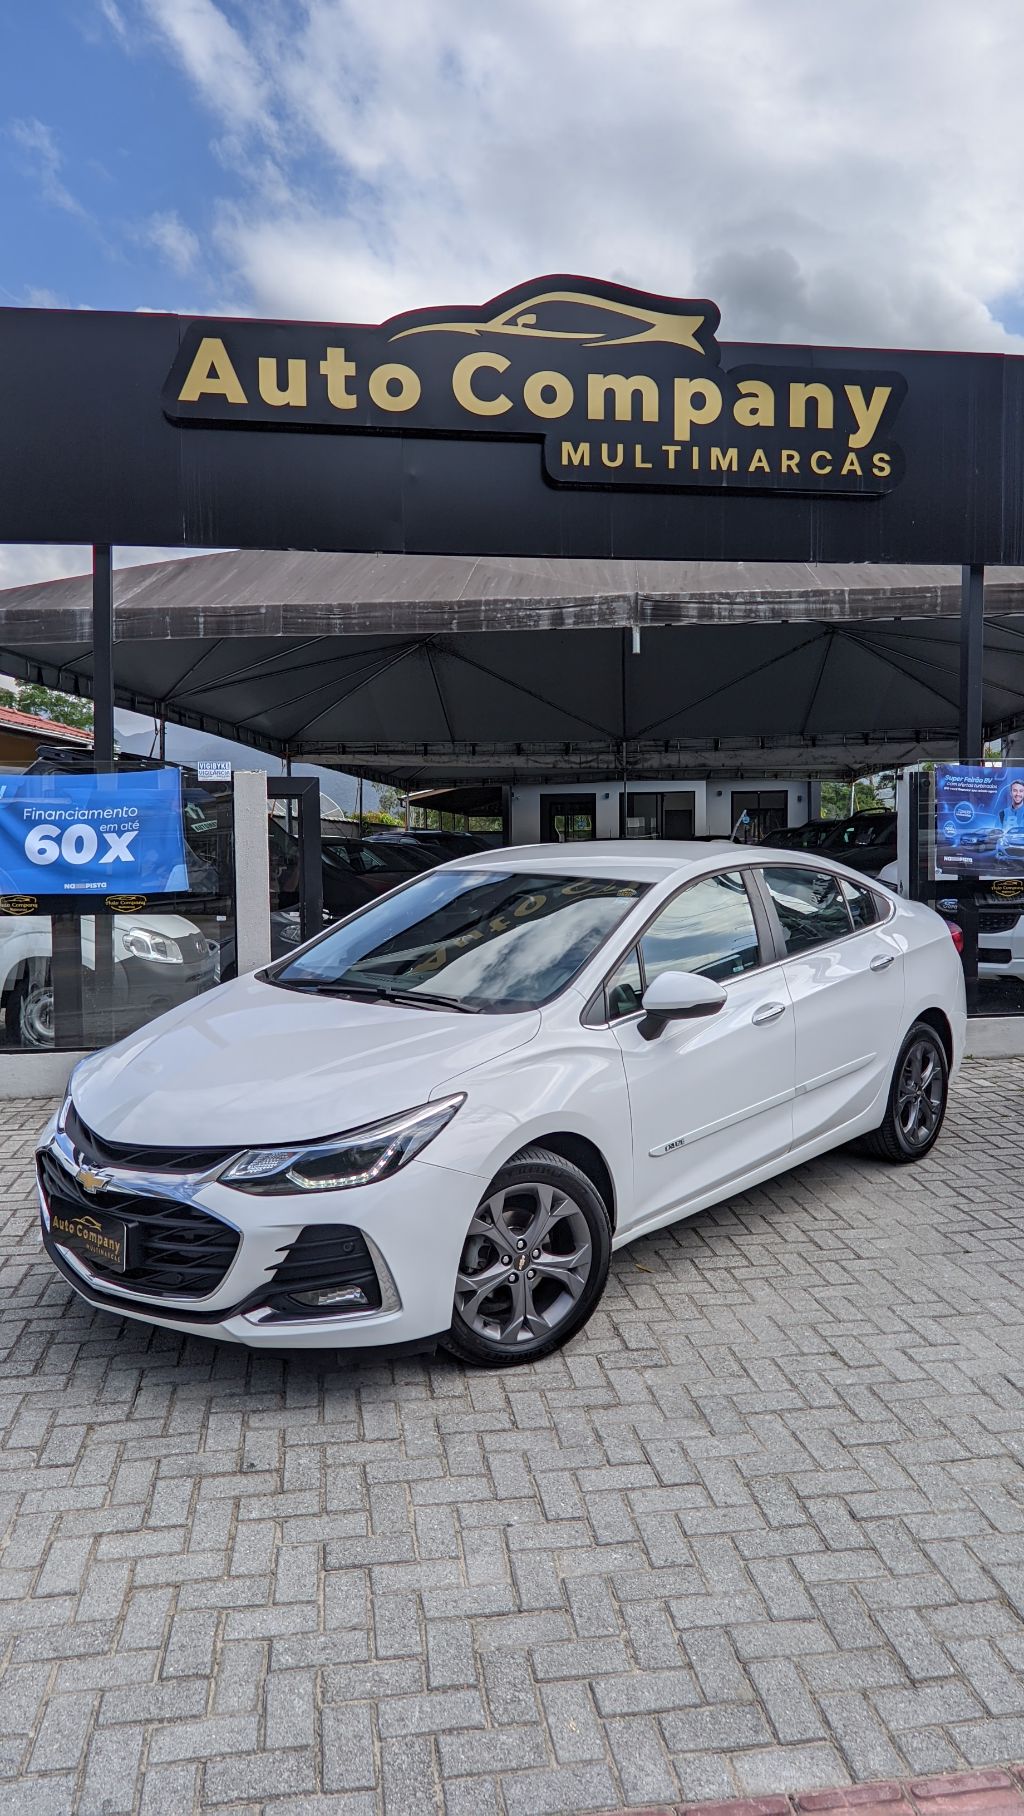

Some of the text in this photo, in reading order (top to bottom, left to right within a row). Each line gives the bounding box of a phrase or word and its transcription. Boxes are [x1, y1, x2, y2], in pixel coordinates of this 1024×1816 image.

[177, 337, 892, 449] Auto Company
[561, 441, 892, 477] MULTIMARCAS
[23, 807, 138, 820] Financiamento
[100, 821, 139, 832] em até
[52, 1215, 121, 1255] Auto Company
